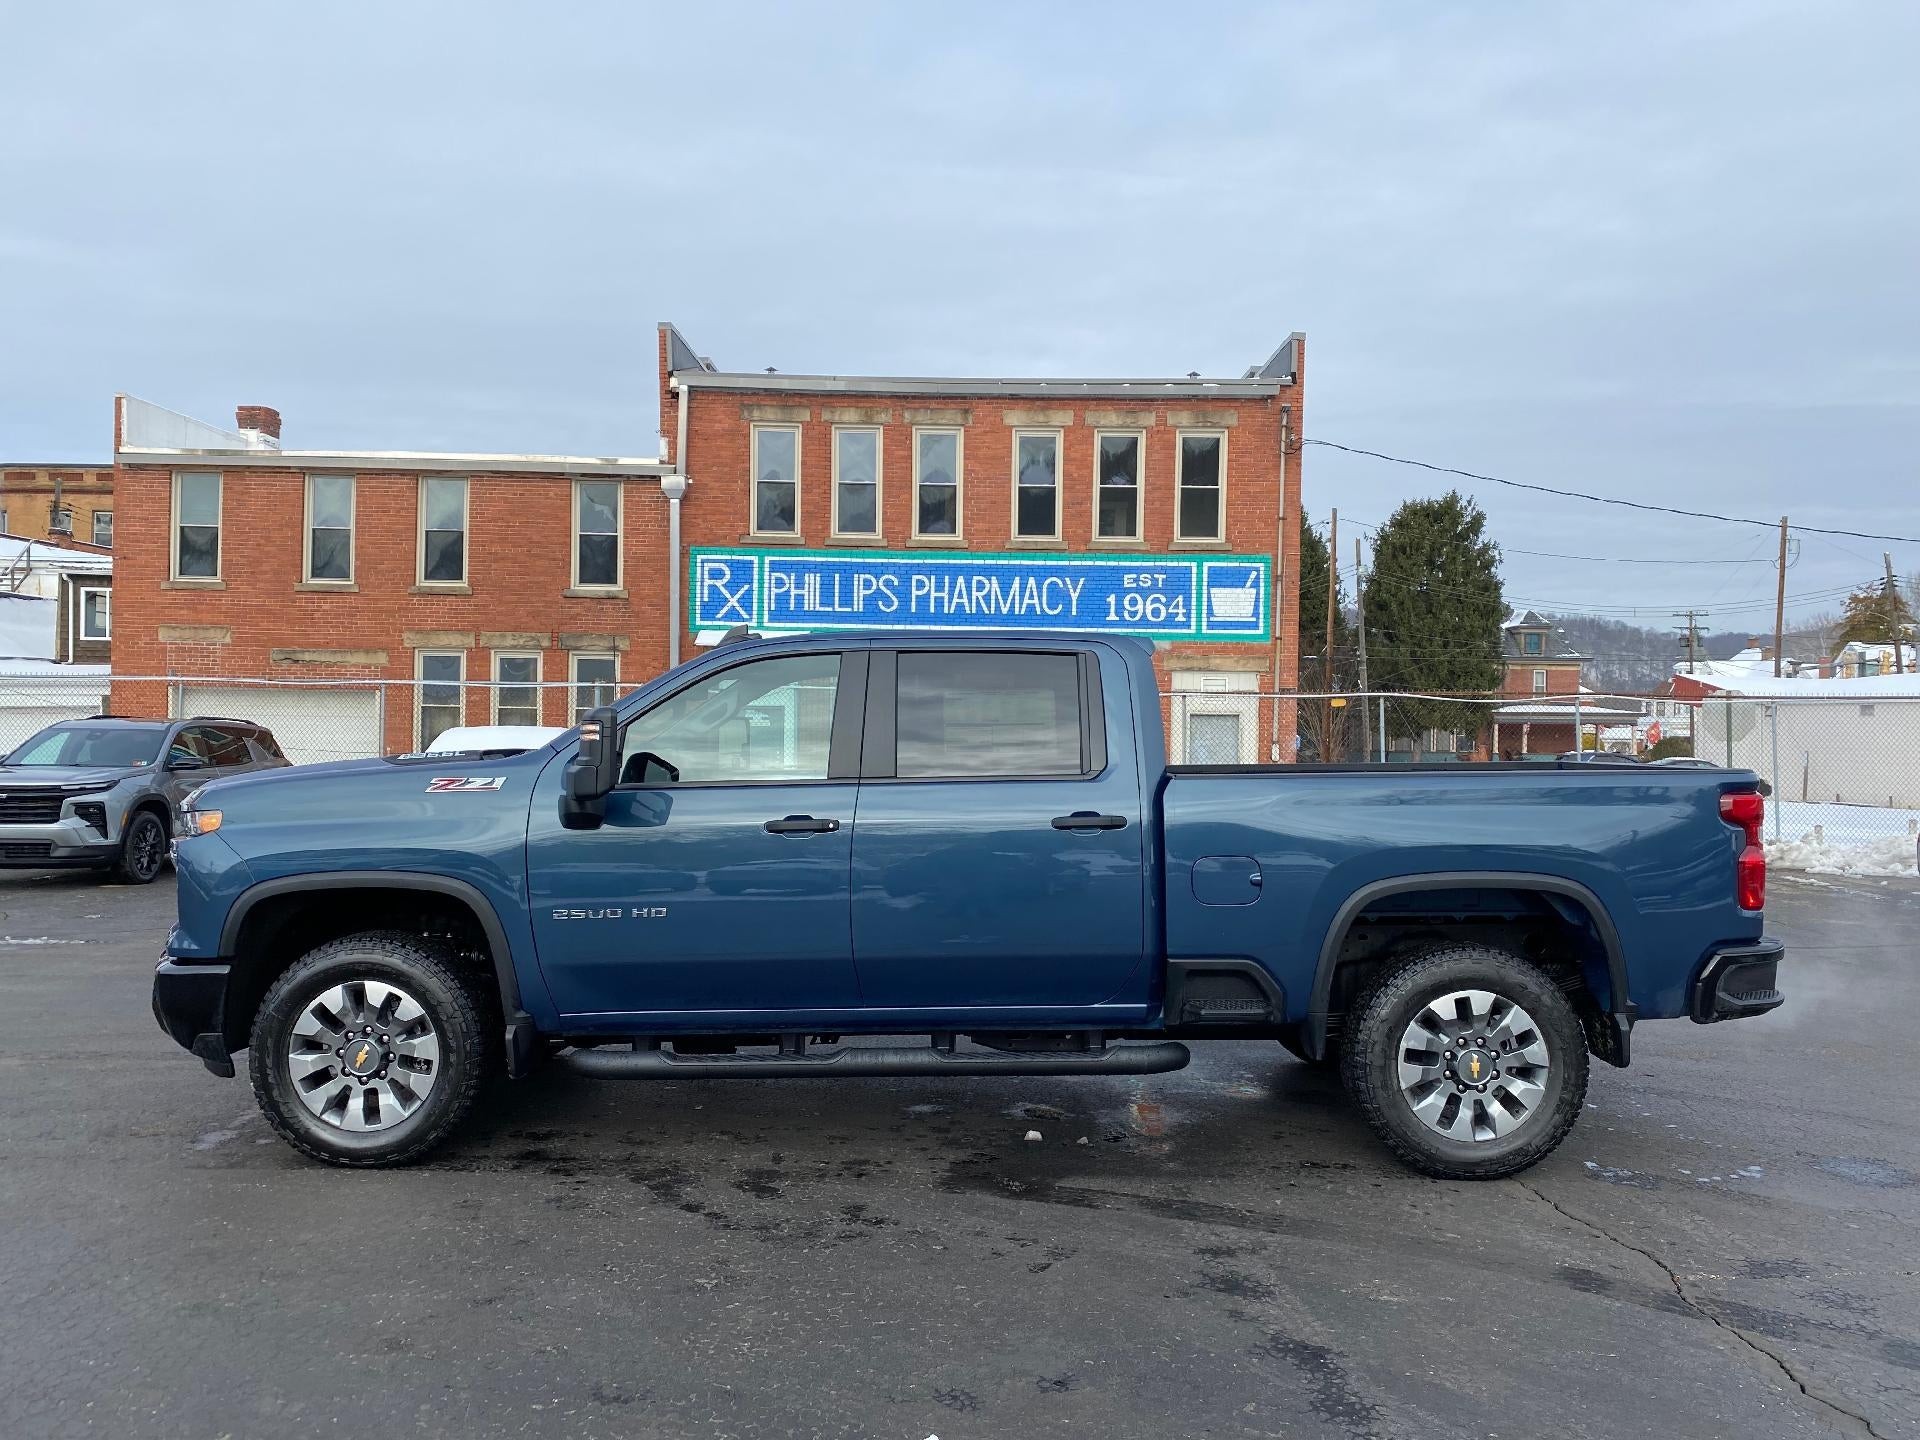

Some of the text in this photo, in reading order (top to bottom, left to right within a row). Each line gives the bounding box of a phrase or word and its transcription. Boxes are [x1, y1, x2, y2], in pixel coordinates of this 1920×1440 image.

[1123, 573, 1167, 588] EST
[770, 572, 1085, 616] PHILLIPS PHARMACY
[1105, 593, 1187, 622] 1964
[425, 776, 508, 793] Z71
[552, 907, 667, 920] 2500 HD
